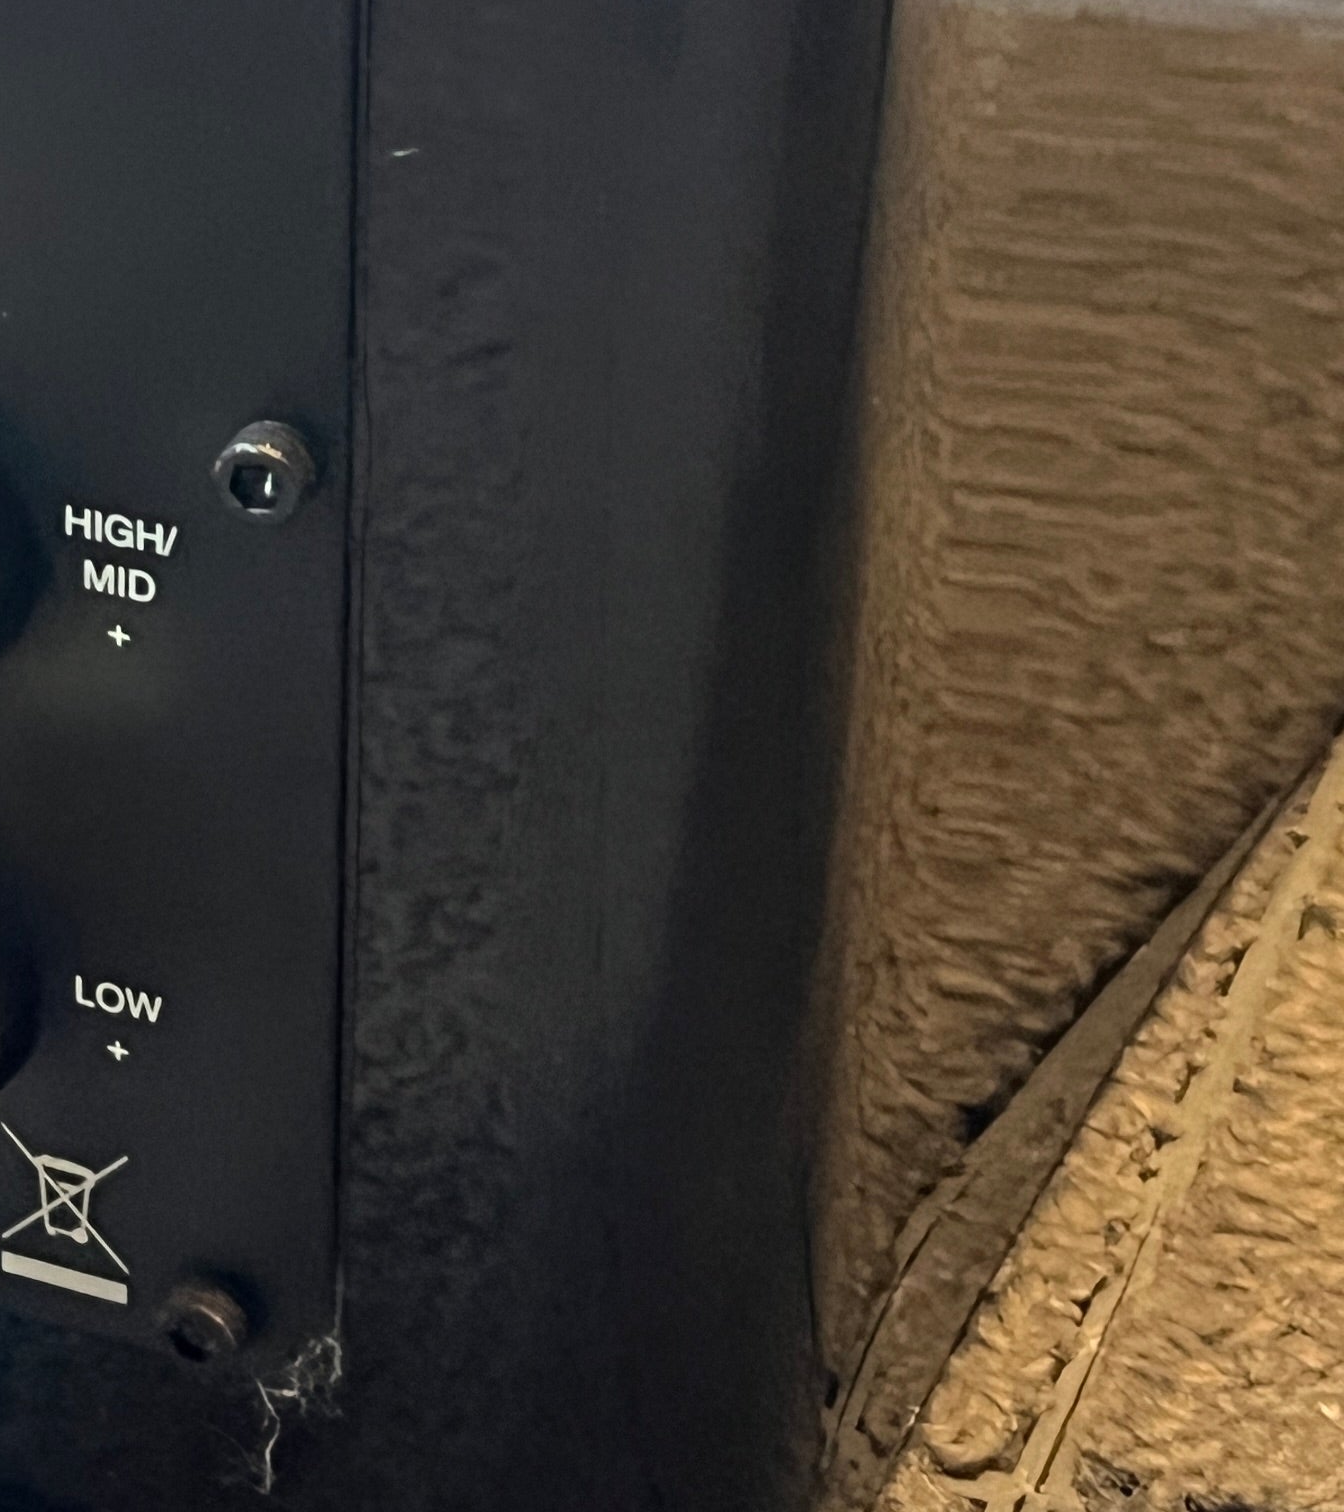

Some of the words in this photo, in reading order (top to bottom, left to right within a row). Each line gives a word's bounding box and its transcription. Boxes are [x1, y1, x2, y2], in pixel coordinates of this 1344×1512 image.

[64, 504, 178, 557] HIGH/
[83, 559, 156, 603] MID
[75, 974, 163, 1023] LOW
